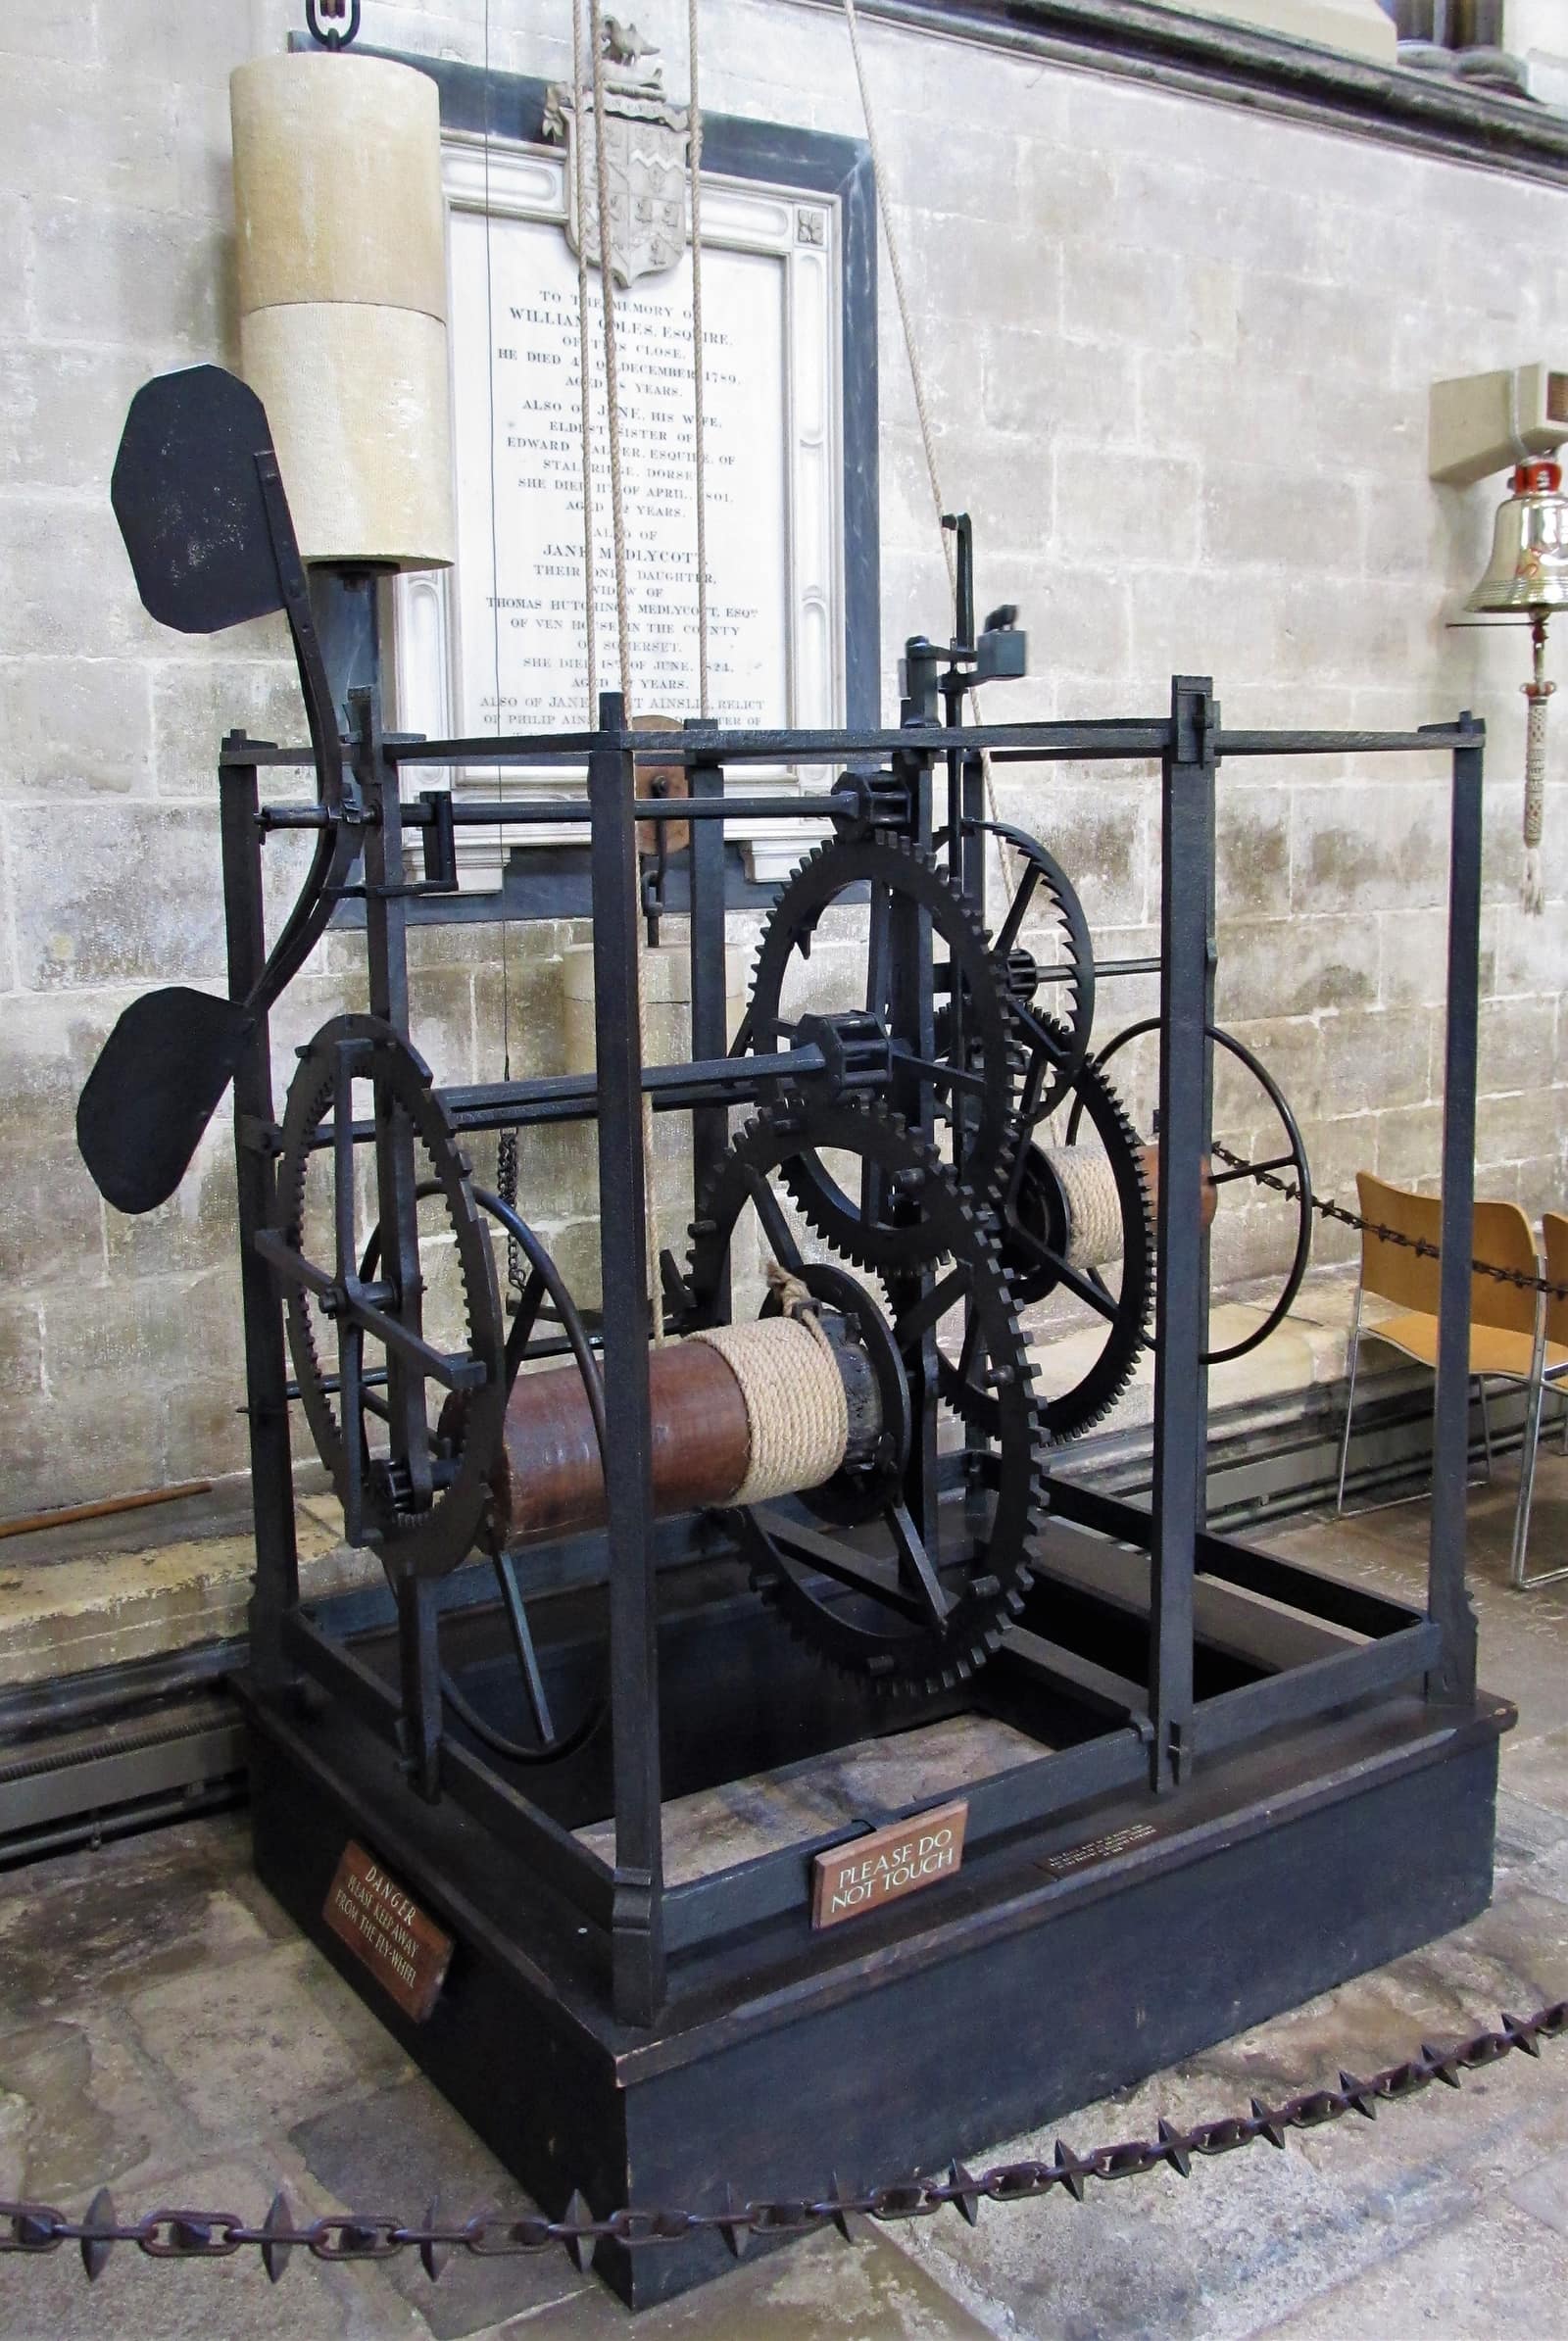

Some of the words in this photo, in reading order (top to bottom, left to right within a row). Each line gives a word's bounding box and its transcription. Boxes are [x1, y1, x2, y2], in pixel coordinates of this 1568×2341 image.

[539, 290, 562, 303] TO
[498, 348, 517, 361] HE
[527, 352, 562, 365] DIED
[621, 362, 696, 380] DECEMBER
[522, 400, 562, 412] ALSO
[651, 412, 674, 422] HIS
[682, 415, 722, 428] WFE,
[508, 437, 570, 452] EDWARD
[718, 456, 735, 465] OF
[518, 477, 547, 489] SHE
[623, 485, 640, 495] OF
[639, 530, 658, 541] OF
[533, 564, 580, 577] THEIR
[646, 588, 663, 598] OF
[486, 597, 542, 610] THOMAS
[510, 618, 528, 629] OF
[535, 619, 564, 630] VEN
[646, 623, 674, 634] THE
[523, 658, 551, 668] SHE
[480, 697, 517, 707] ALSO
[524, 697, 542, 707] OF
[509, 714, 556, 725] PHILIP
[747, 717, 761, 728] OF
[839, 1843, 913, 1889] PLEASE
[918, 1829, 953, 1856] DO
[831, 1879, 877, 1914] NOT
[883, 1847, 954, 1891] TOUCH
[365, 1865, 416, 1926] DANGER
[334, 1888, 359, 1923] FROM
[359, 1915, 376, 1943] THE
[372, 1903, 394, 1930] KEEP
[390, 1924, 419, 1959] AWAY
